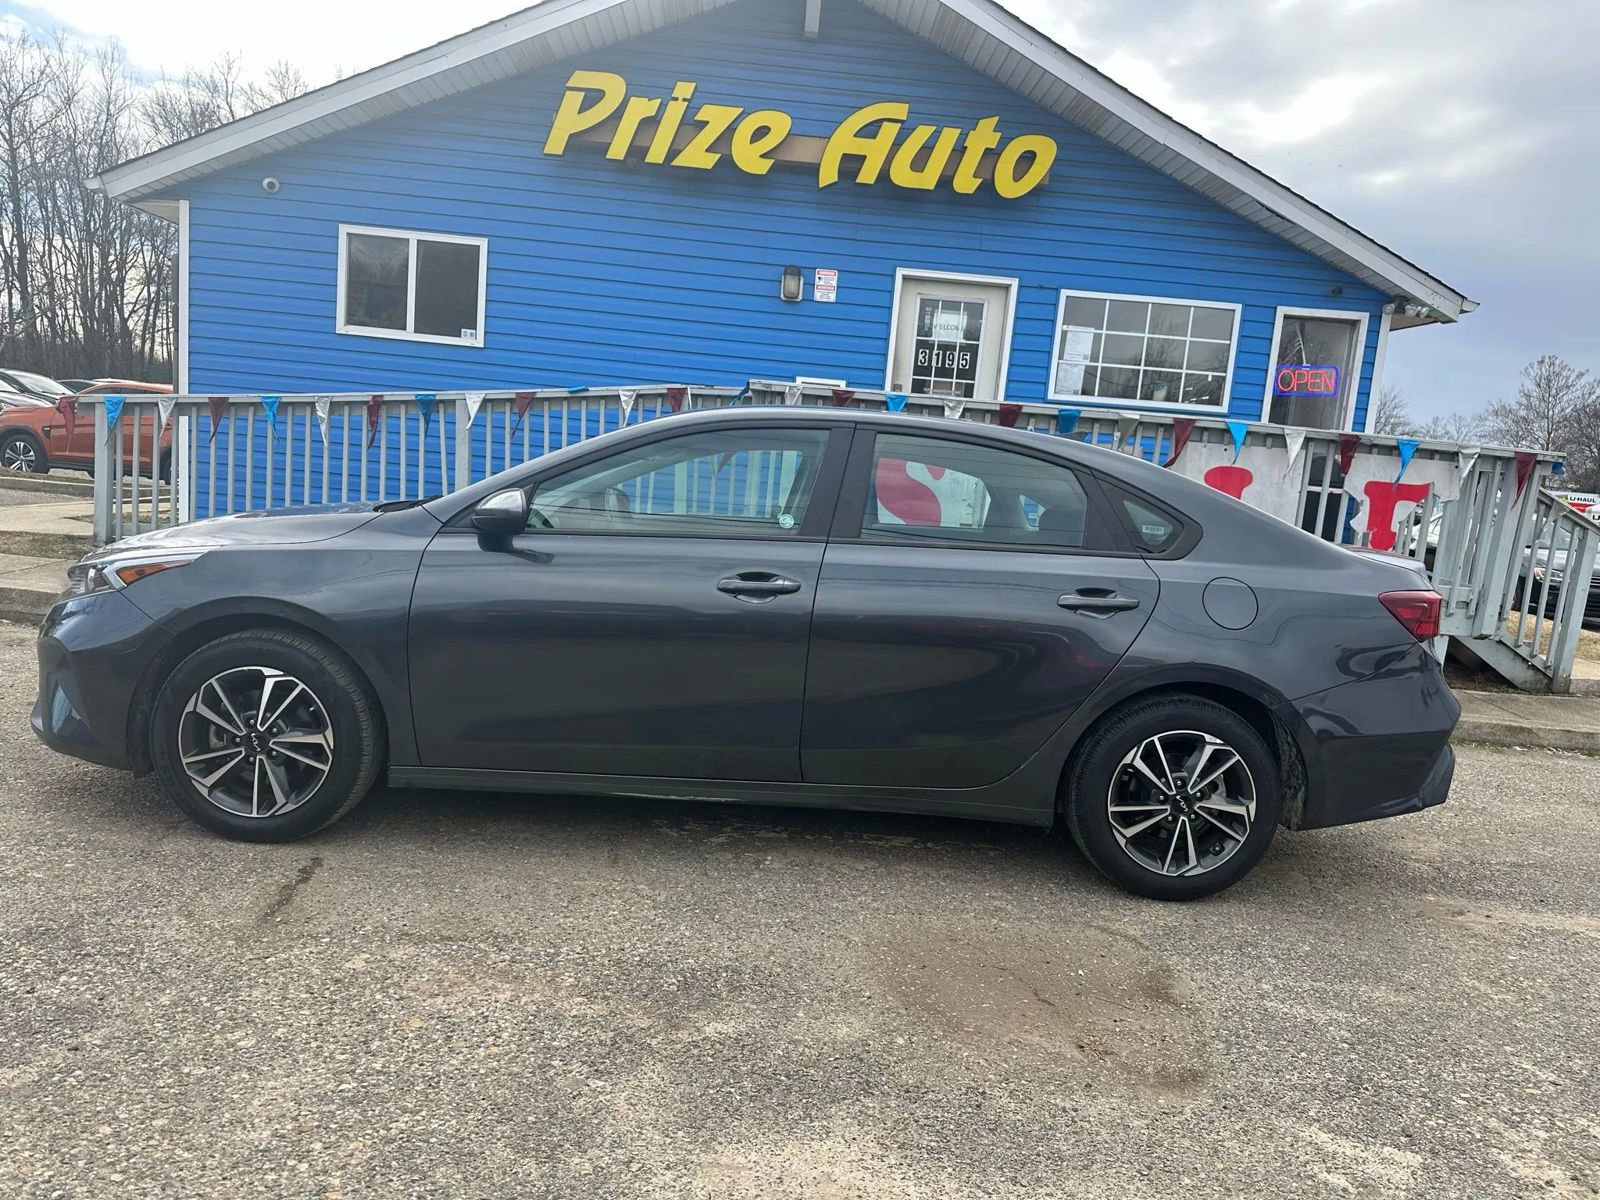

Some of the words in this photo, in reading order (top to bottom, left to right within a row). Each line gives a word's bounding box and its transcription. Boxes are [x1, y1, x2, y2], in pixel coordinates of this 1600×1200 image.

[543, 70, 792, 175] Prize
[818, 102, 1058, 199] Auto
[920, 350, 969, 368] 3195
[1278, 368, 1336, 392] OPEN
